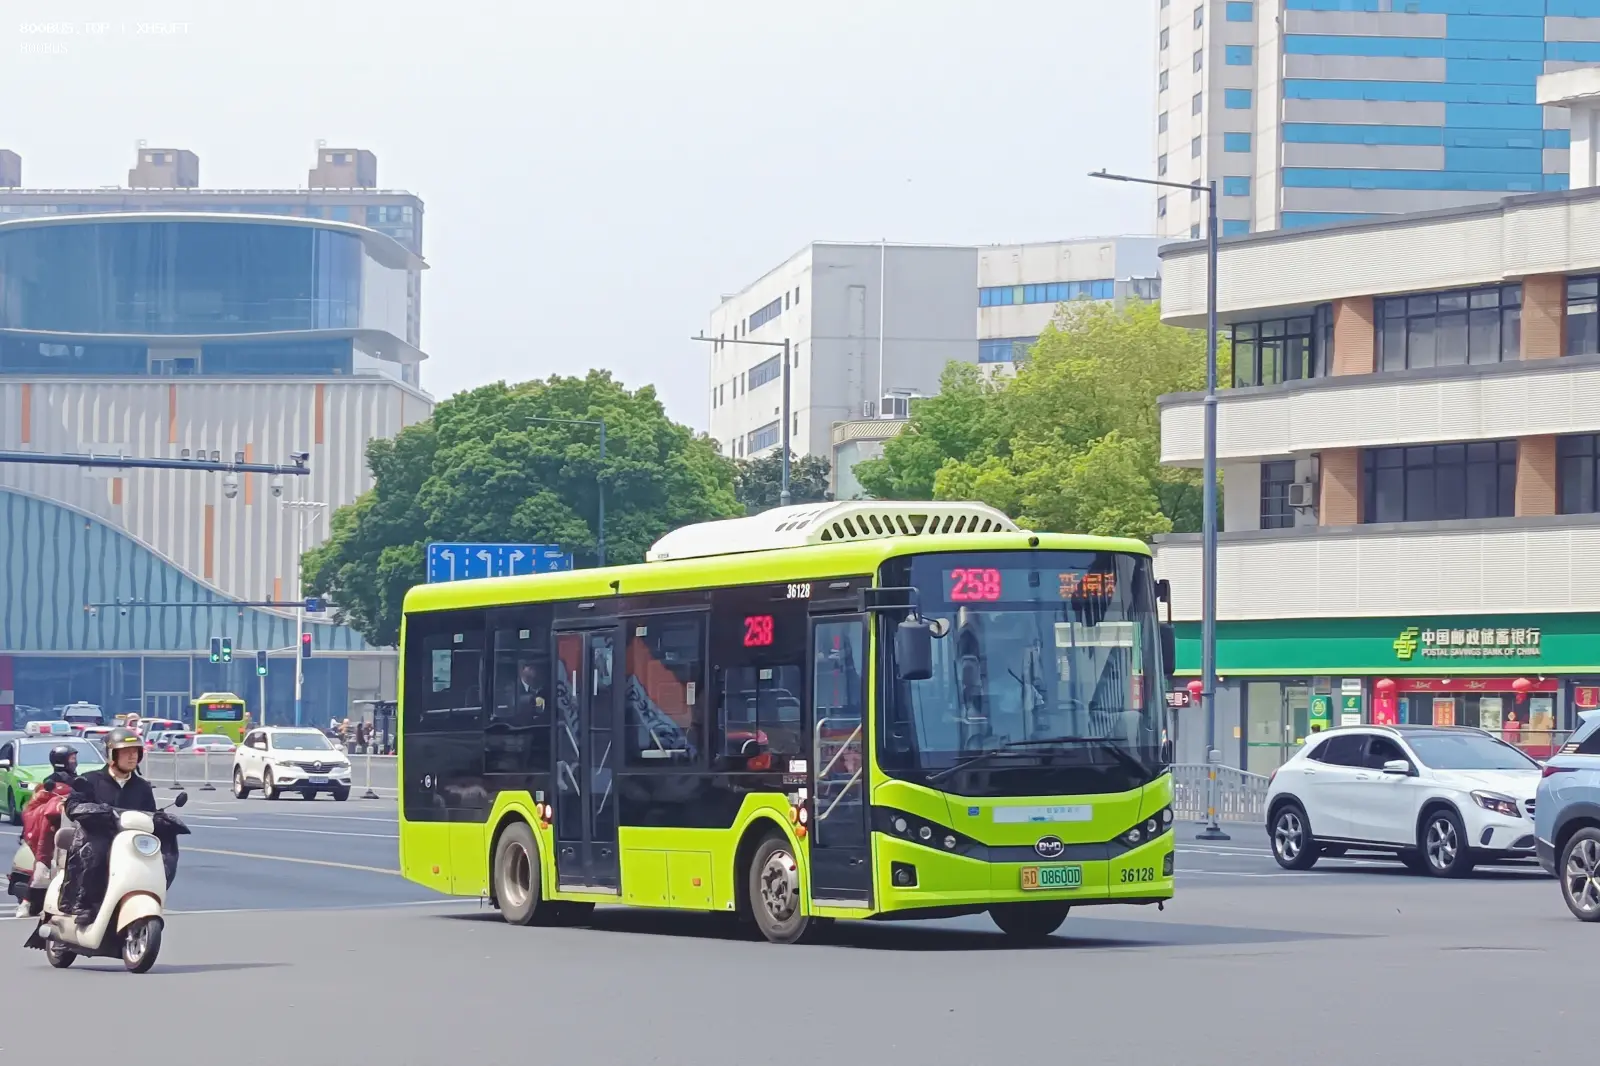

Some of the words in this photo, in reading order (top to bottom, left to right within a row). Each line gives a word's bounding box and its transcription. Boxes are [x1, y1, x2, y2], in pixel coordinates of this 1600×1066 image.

[786, 583, 811, 599] 36128
[951, 568, 1001, 601] 258
[743, 614, 774, 648] 258
[1421, 628, 1541, 647] 中国邮政储蓄银行
[1421, 648, 1449, 656] POSTAL
[1450, 648, 1481, 656] SAVINGS
[1482, 648, 1504, 656] BANK
[1505, 648, 1515, 656] OF
[1517, 648, 1541, 656] CHINA
[1038, 842, 1061, 851] BYD
[1120, 867, 1154, 883] 36128
